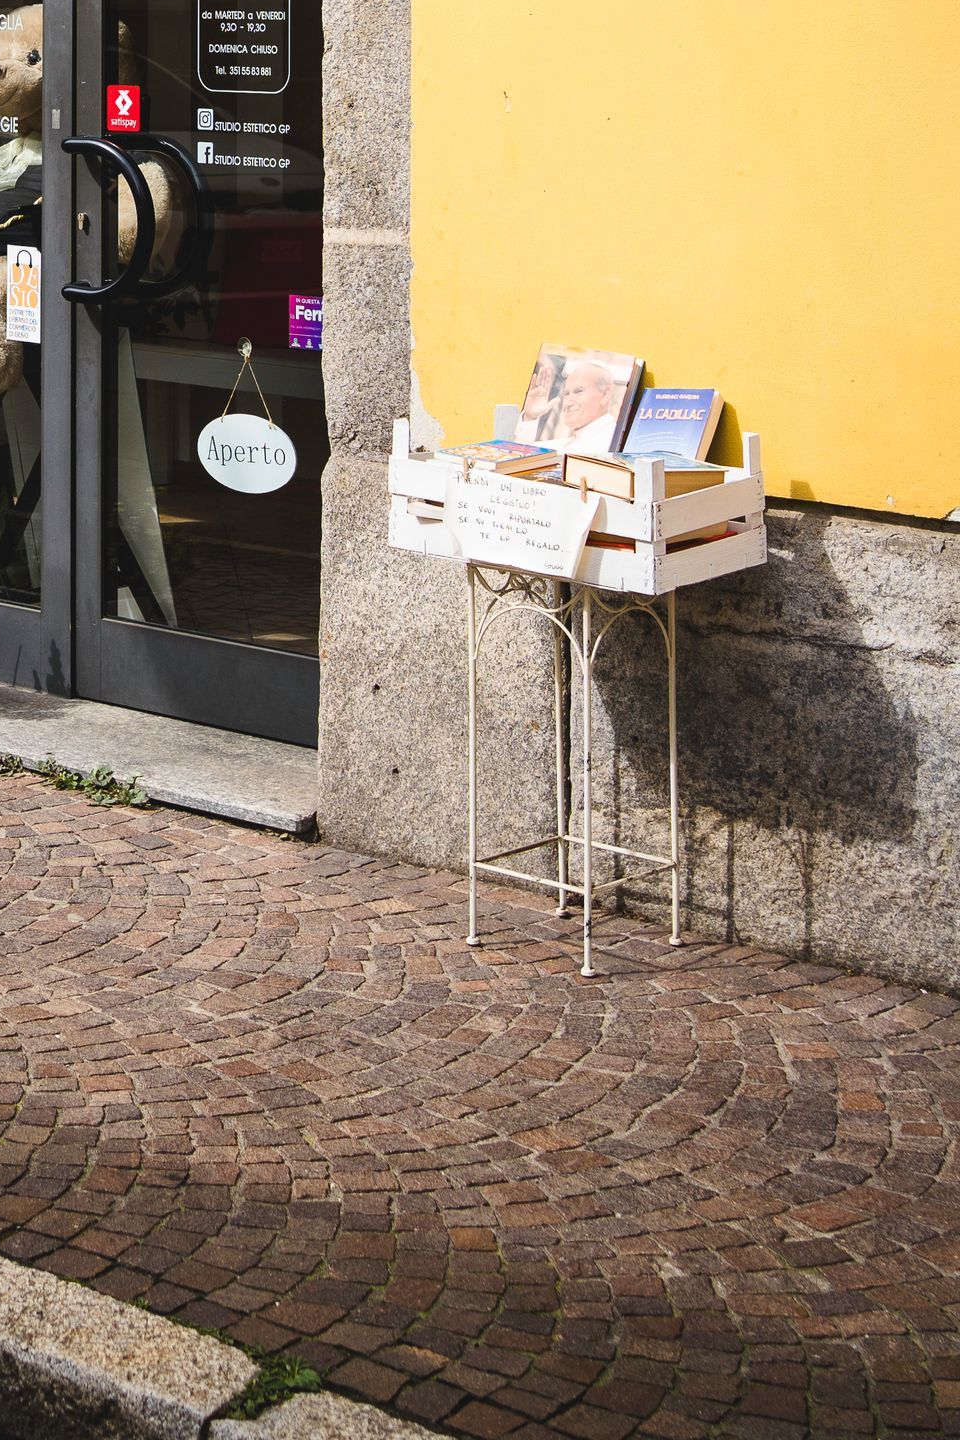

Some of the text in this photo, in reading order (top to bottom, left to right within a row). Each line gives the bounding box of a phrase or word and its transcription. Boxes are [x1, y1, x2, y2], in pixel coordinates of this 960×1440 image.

[202, 11, 212, 19] da
[215, 11, 244, 20] MARTEDI
[256, 11, 285, 20] VENERDI
[221, 23, 236, 32] 9,30
[247, 23, 266, 32] 19,30
[209, 44, 278, 54] DOMENICA CHIUSO
[215, 66, 226, 75] Tel.
[111, 117, 136, 128] satispay
[215, 122, 290, 134] STUDIO ESTETICO GP
[215, 155, 241, 165] STUDIO
[244, 156, 276, 168] ESTETICO
[279, 159, 290, 168] GP
[640, 408, 705, 420] LA CADILLAC
[207, 434, 286, 466] Aperto
